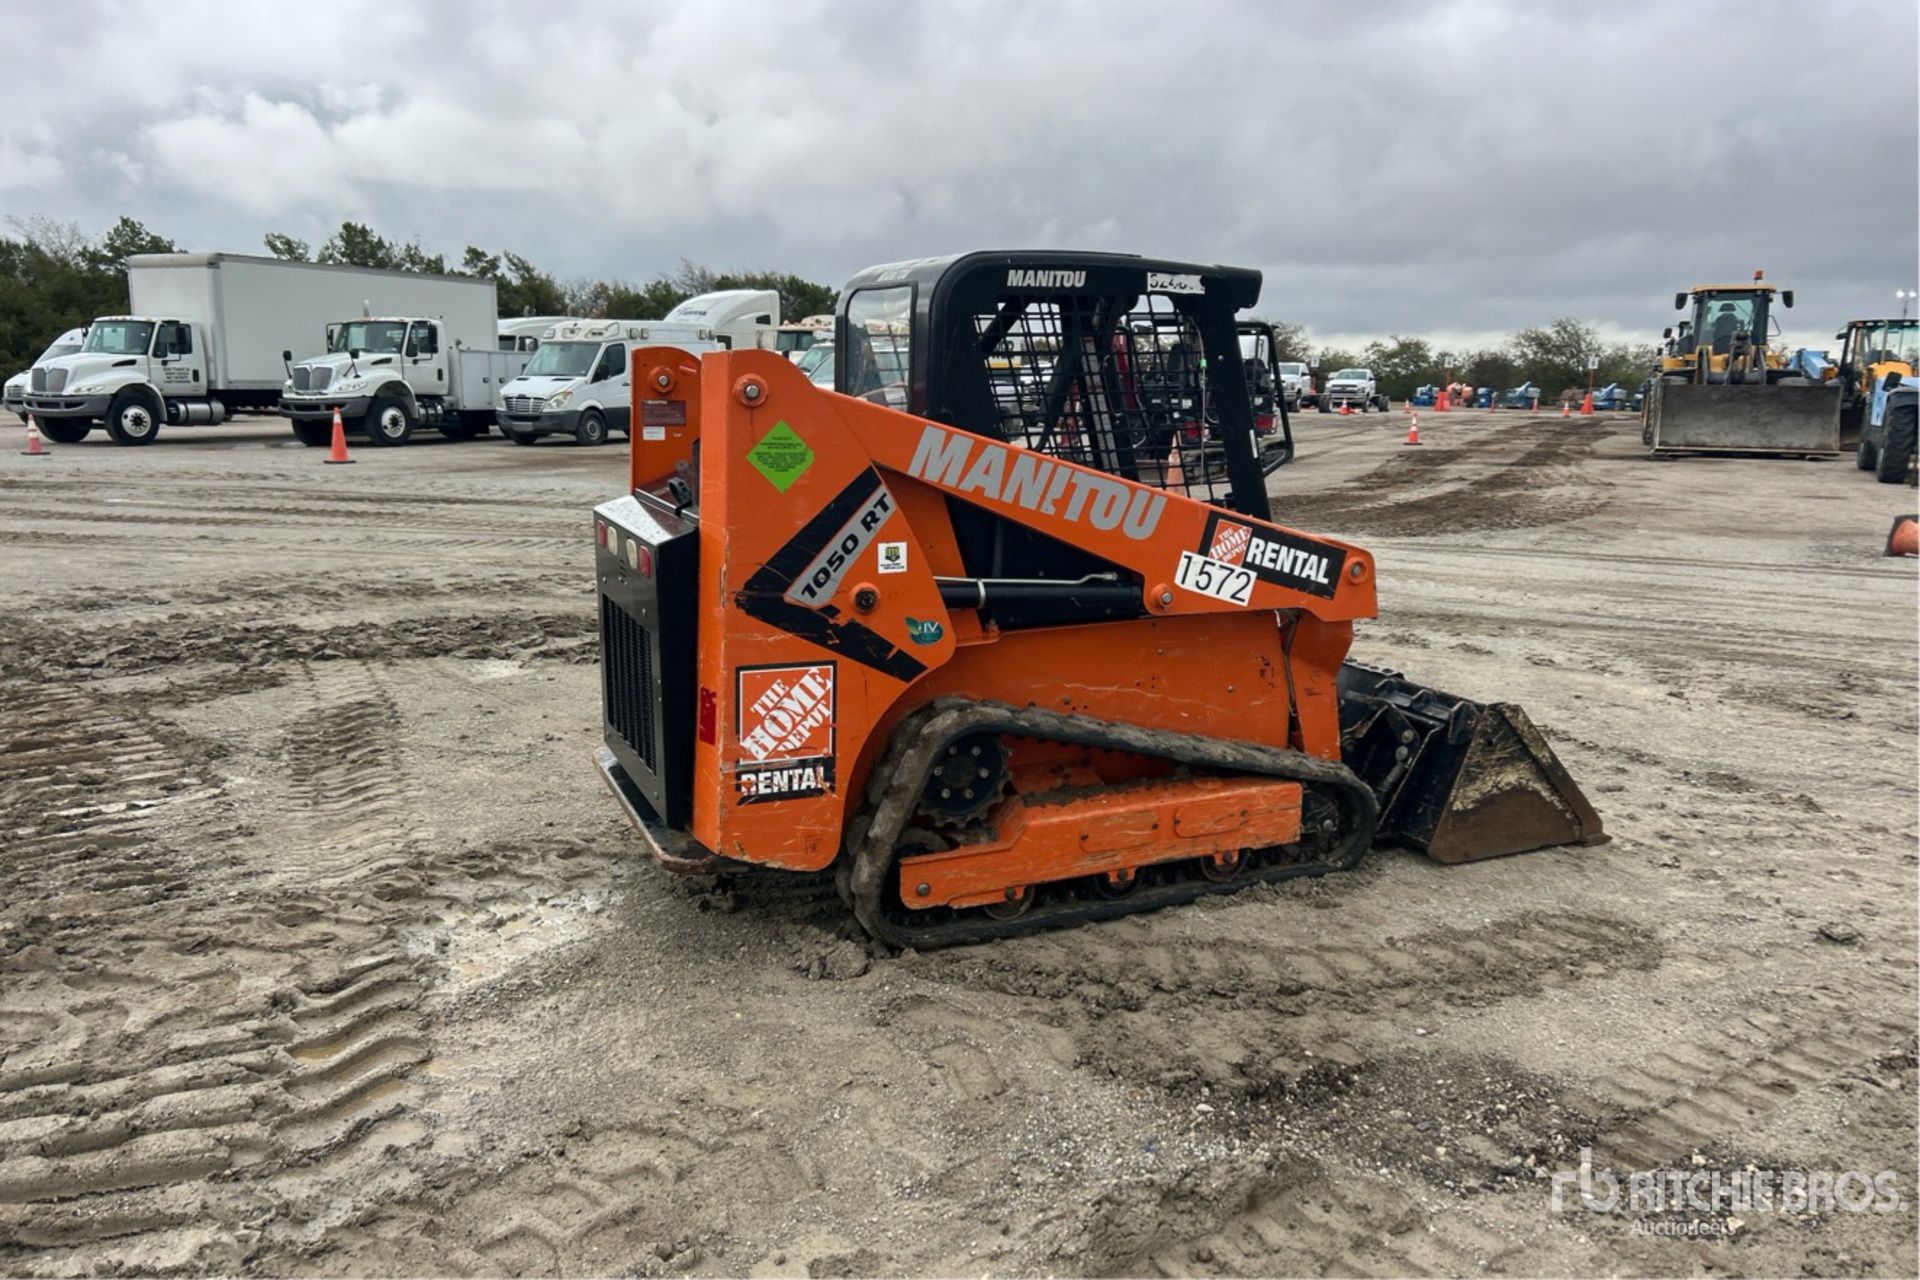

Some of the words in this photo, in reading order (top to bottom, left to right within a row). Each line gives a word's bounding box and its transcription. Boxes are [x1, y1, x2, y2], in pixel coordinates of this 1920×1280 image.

[1007, 270, 1086, 288] MANITOU
[906, 425, 1168, 540] MANITOU
[801, 533, 860, 599] 1050
[861, 493, 890, 533] RT
[1210, 526, 1250, 560] HOME
[1218, 526, 1235, 542] THE
[1180, 554, 1251, 603] 1572
[1246, 536, 1329, 584] RENTAL
[741, 667, 832, 761] HOME
[749, 678, 790, 718] THE
[776, 700, 831, 752] DEPOT
